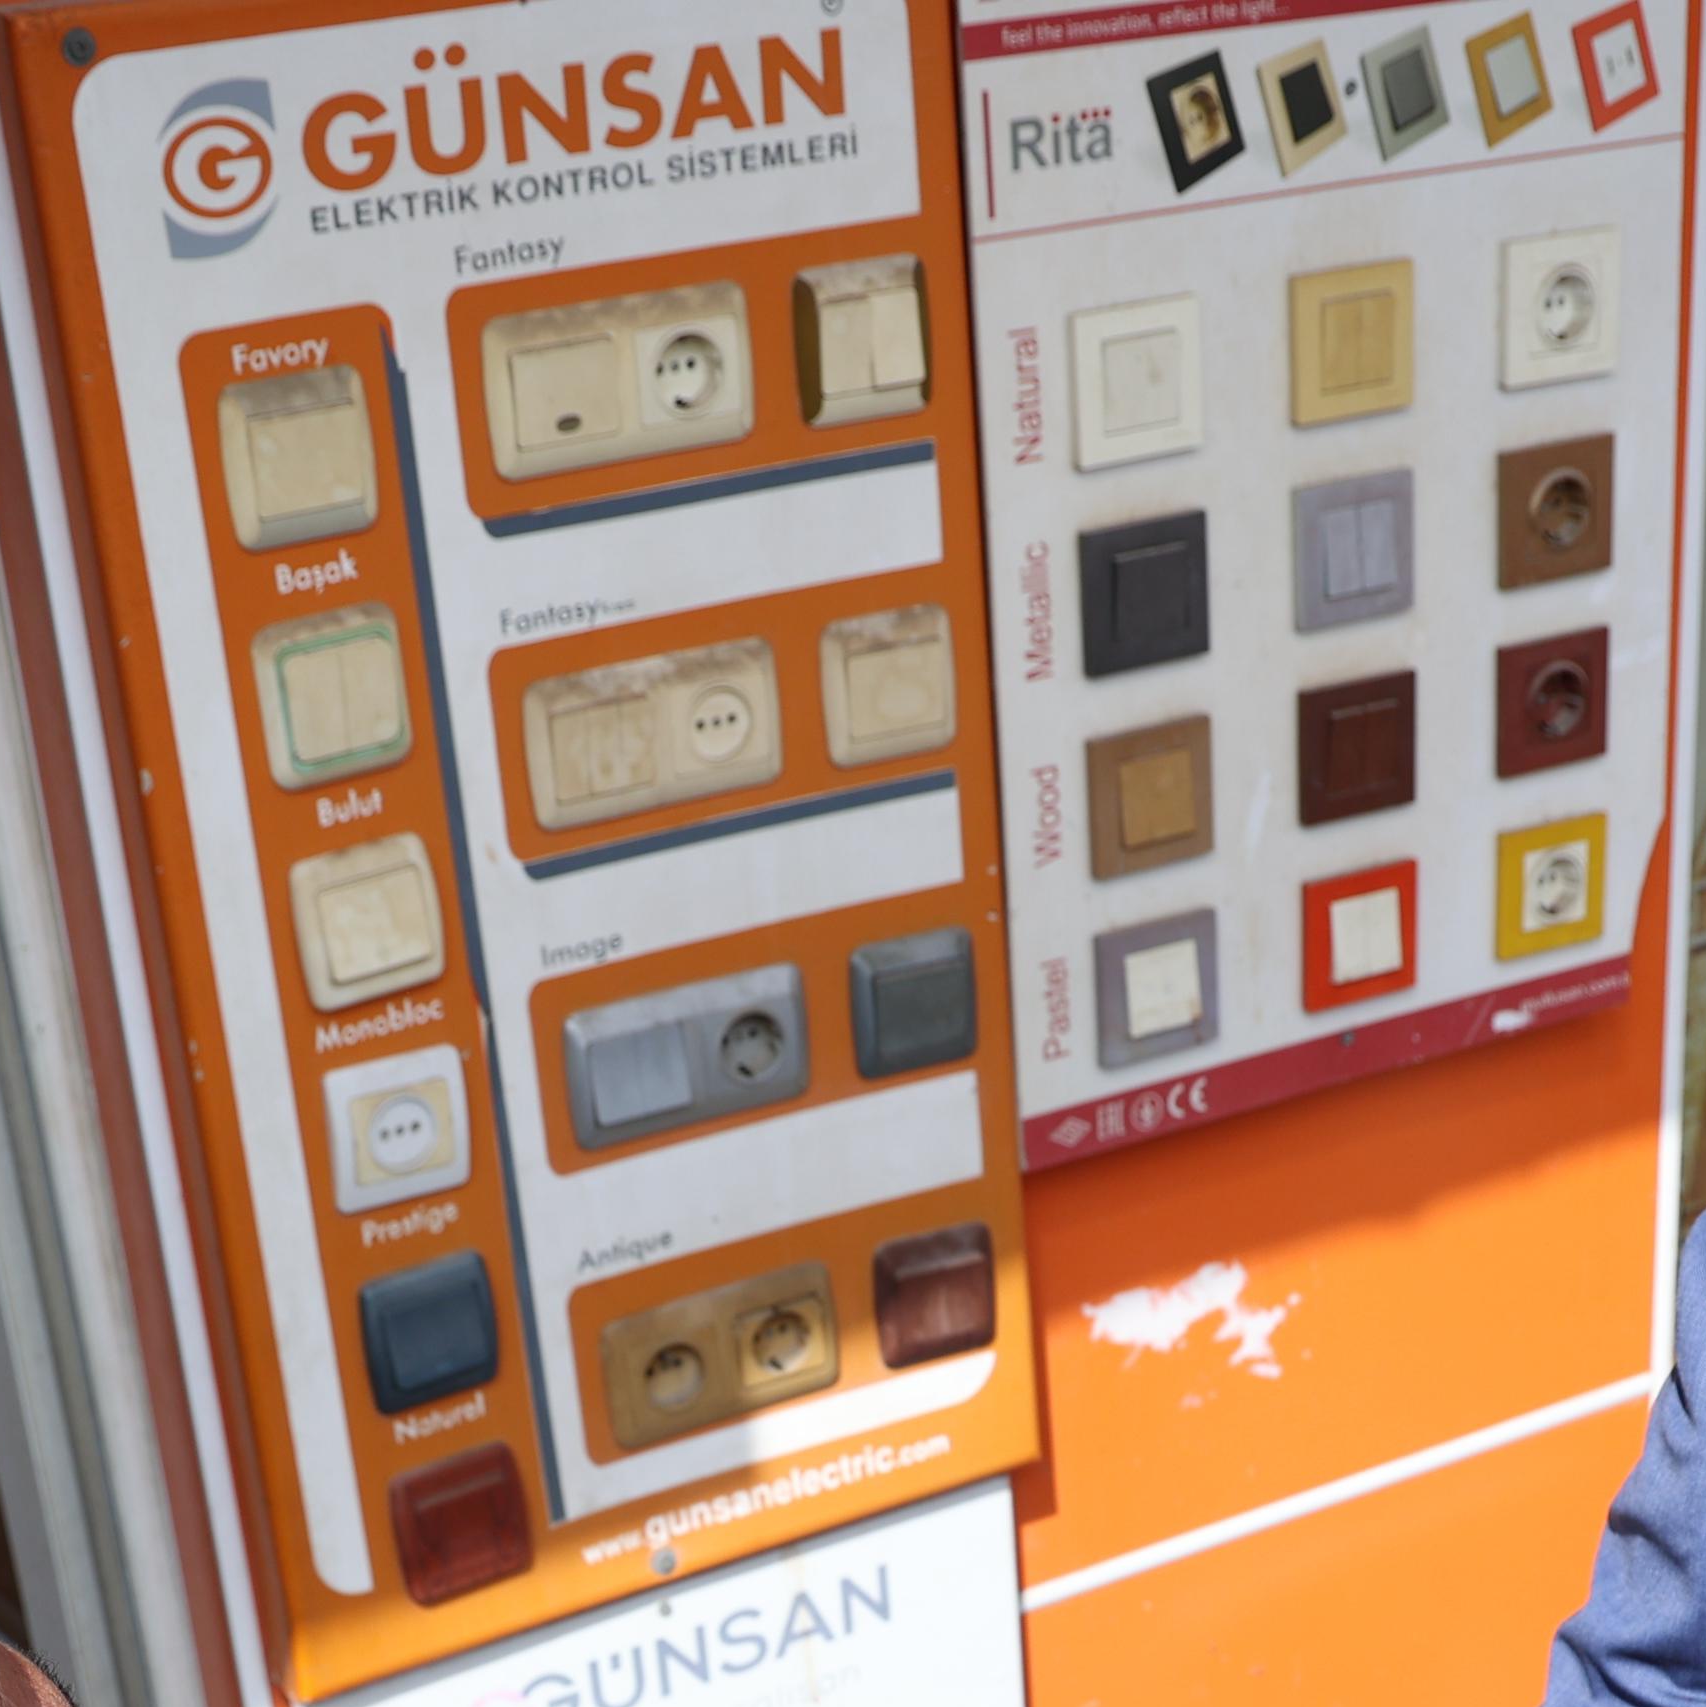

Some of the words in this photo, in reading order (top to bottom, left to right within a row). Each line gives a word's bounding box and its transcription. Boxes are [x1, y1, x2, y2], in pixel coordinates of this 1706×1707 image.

[1001, 24, 1033, 48] feel
[1035, 21, 1063, 42] the
[302, 28, 846, 192] GÜNSAN
[493, 162, 655, 210] KONTROL
[454, 234, 566, 276] Fantasy
[230, 333, 330, 375] Favory
[1011, 325, 1044, 466] Natural
[499, 596, 601, 637] Fantasy
[1026, 541, 1052, 683] Metallic
[316, 787, 385, 828] Bulut
[1034, 764, 1062, 870] Wood
[540, 930, 624, 970] Image
[314, 995, 445, 1054] Monobloc
[1044, 956, 1070, 1063] Pastel
[362, 1199, 460, 1249] Prestige
[577, 1226, 674, 1274] Antique
[394, 1392, 488, 1446] Naturel
[582, 1434, 950, 1566] www.gunsanelectric.com
